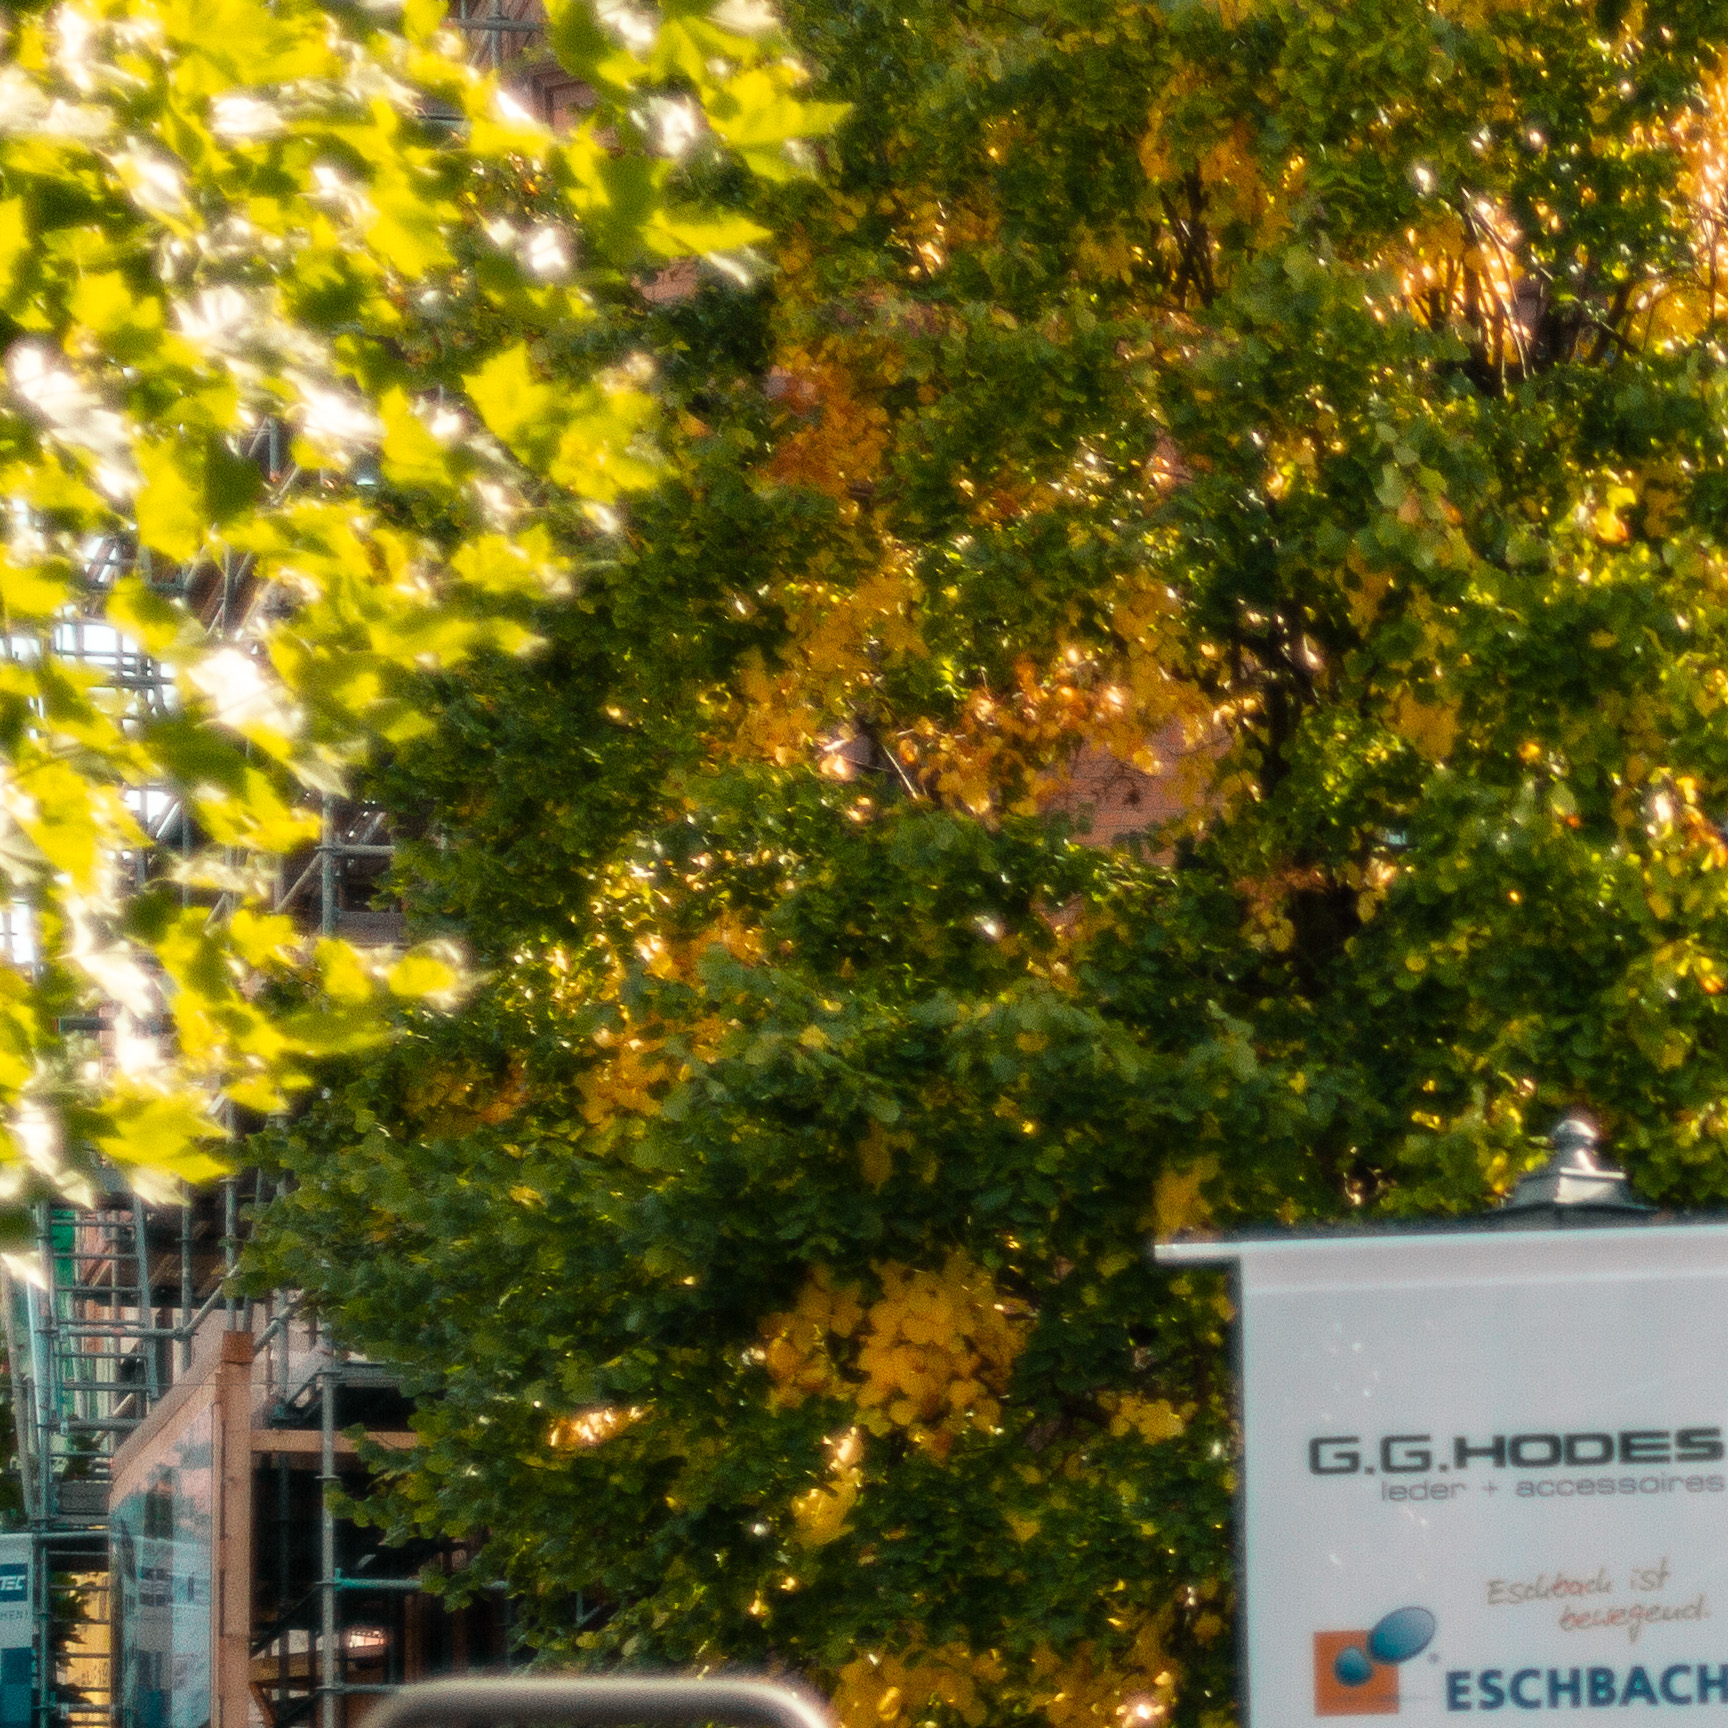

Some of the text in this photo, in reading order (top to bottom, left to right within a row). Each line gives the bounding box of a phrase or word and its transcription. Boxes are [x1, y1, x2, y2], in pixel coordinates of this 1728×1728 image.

[1308, 1427, 1726, 1476] G.G.HODES
[1381, 1480, 1467, 1502] leder
[1515, 1472, 1726, 1498] accessoires
